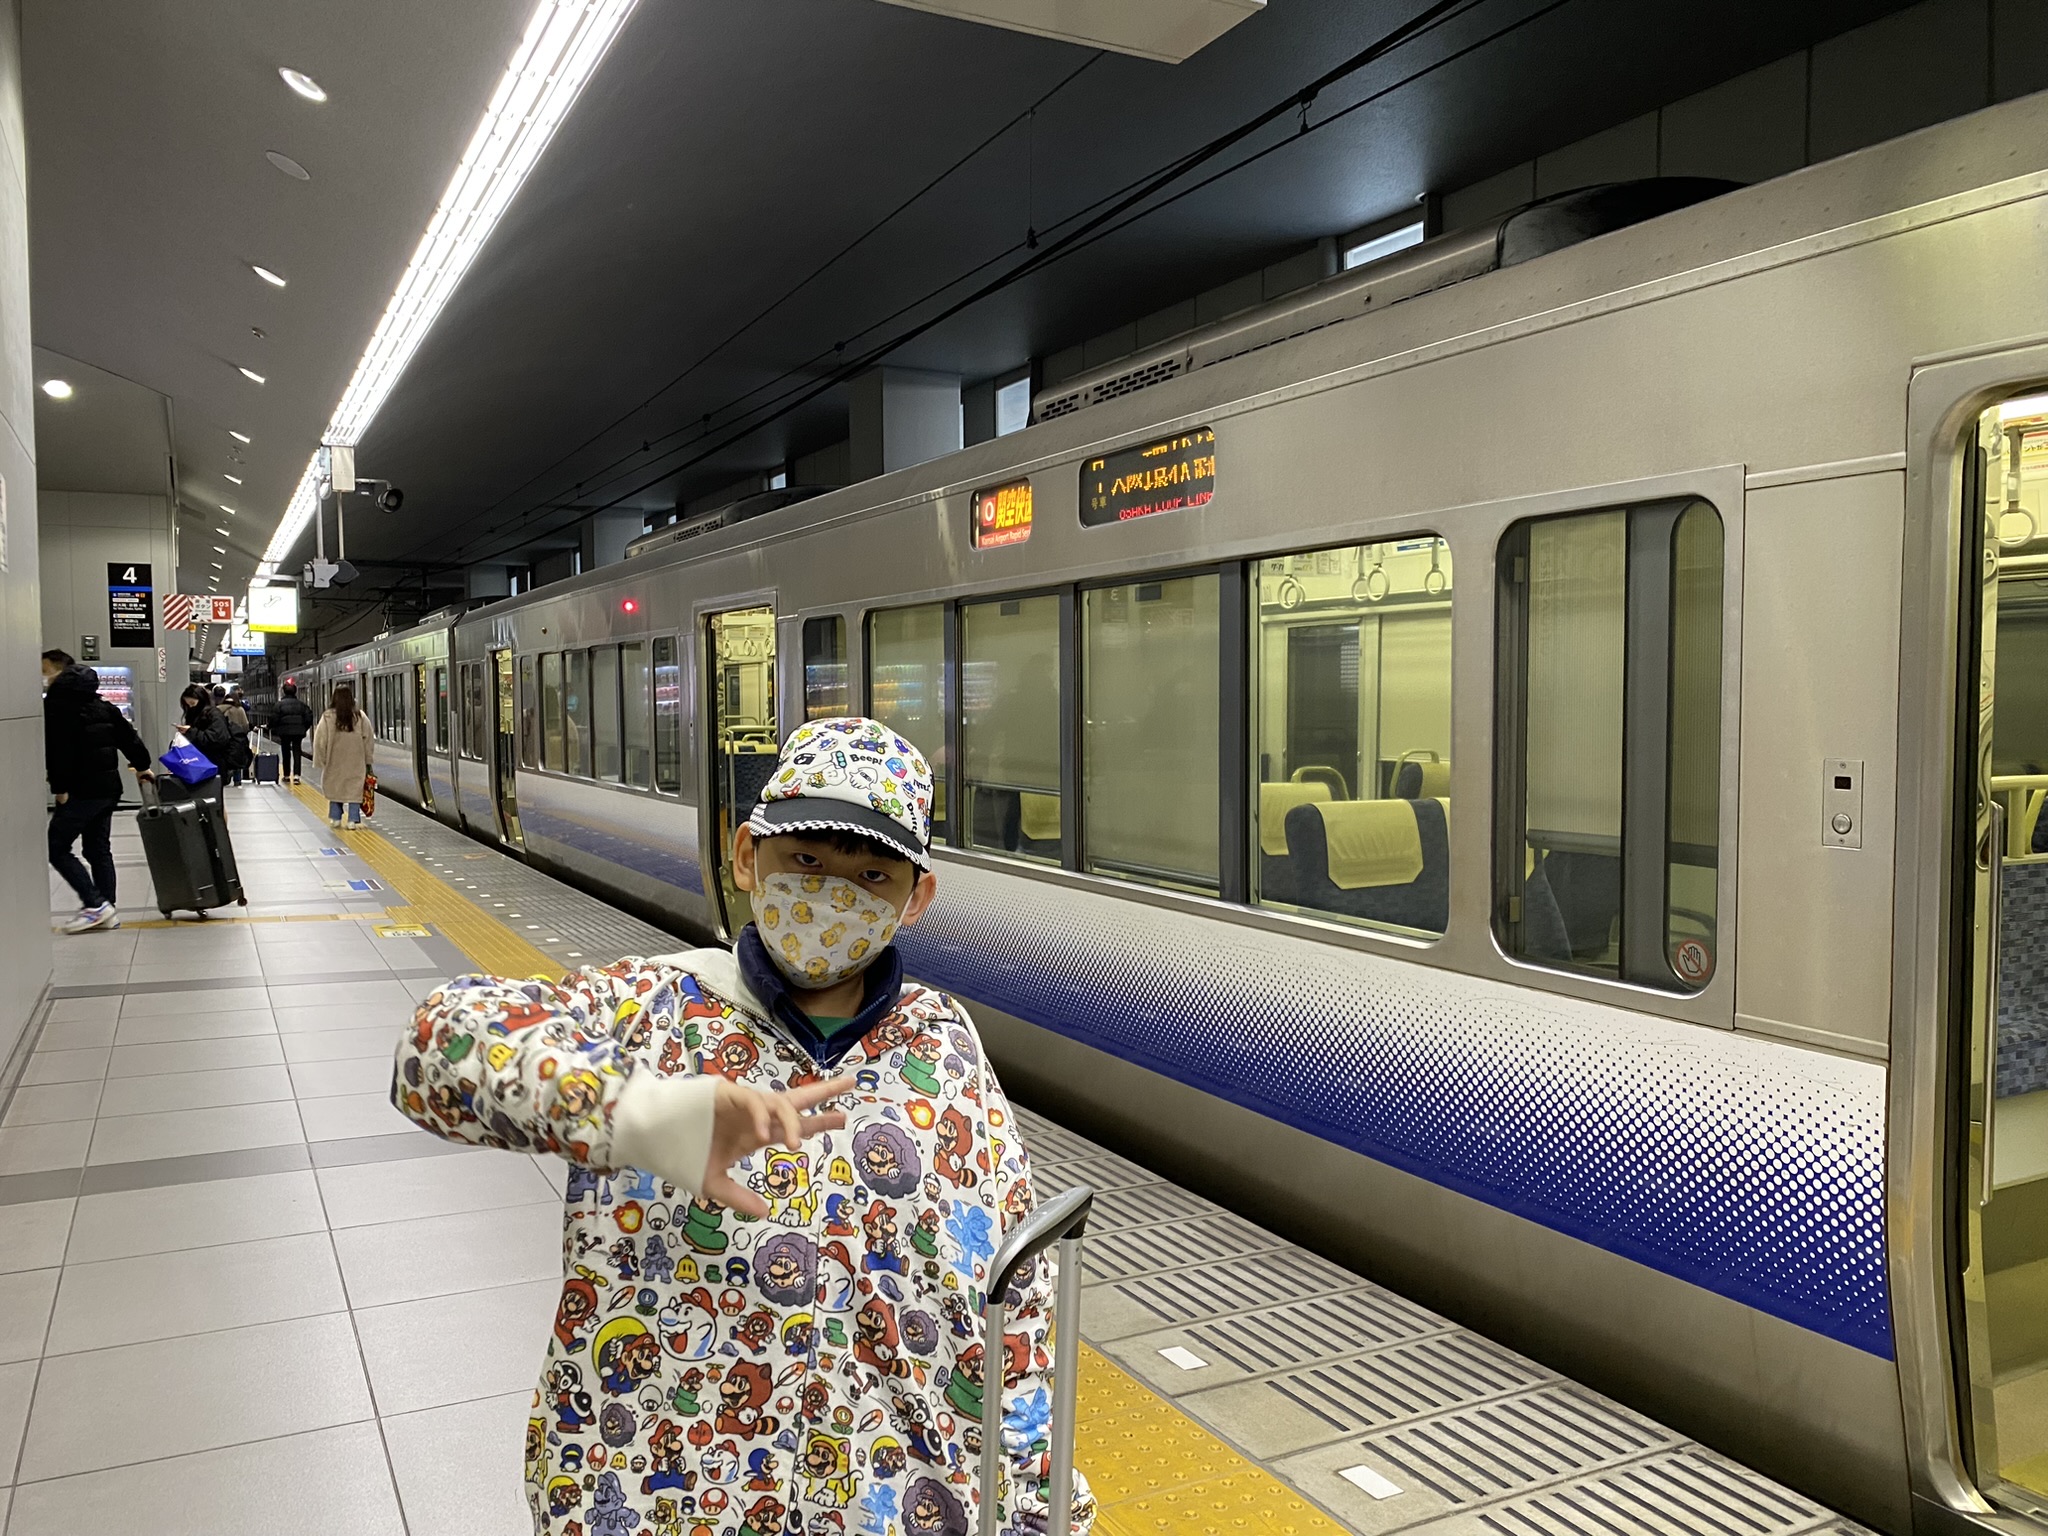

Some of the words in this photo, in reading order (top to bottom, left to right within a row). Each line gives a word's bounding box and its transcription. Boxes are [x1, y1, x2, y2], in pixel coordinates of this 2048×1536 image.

[122, 566, 138, 584] 4
[213, 600, 230, 608] SOS
[242, 629, 254, 642] 4
[849, 753, 883, 766] Beep!
